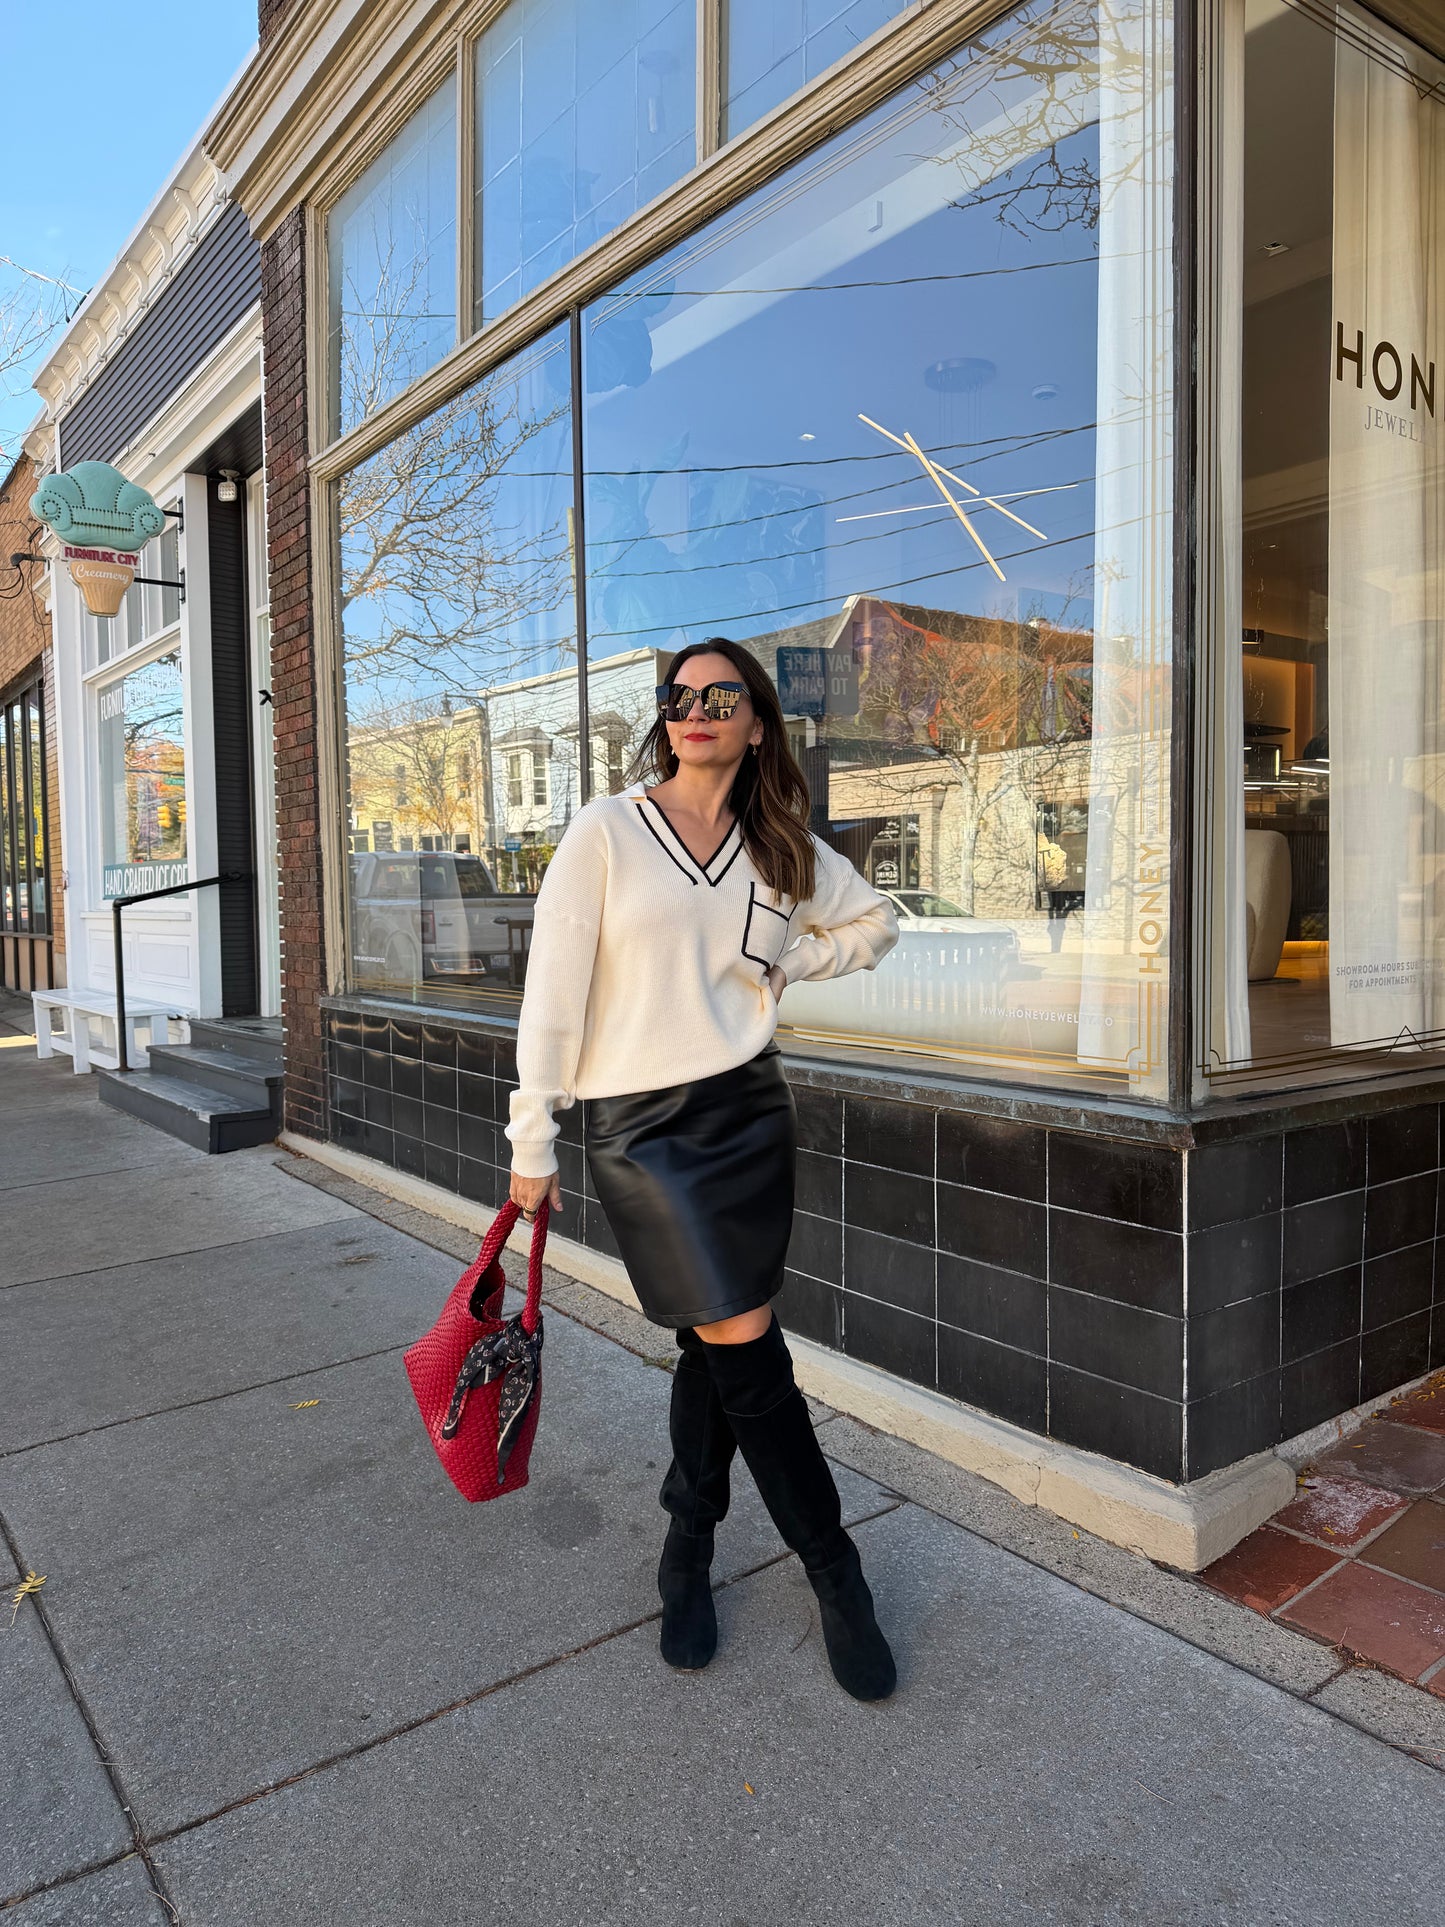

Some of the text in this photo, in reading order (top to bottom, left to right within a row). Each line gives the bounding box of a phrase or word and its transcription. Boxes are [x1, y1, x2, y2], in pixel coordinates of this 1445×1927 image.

[1336, 321, 1445, 421] HON
[64, 546, 139, 566] FURNITURE CITY
[75, 563, 129, 584] Creamery
[105, 868, 123, 896] HAND
[123, 865, 155, 895] CRAFTED
[155, 864, 170, 891] ICE
[1139, 842, 1163, 974] HONEY
[1336, 964, 1379, 976] SHOWROOM
[1381, 962, 1404, 973] HOURS
[1349, 975, 1417, 989] FOR APPOINTMENTS
